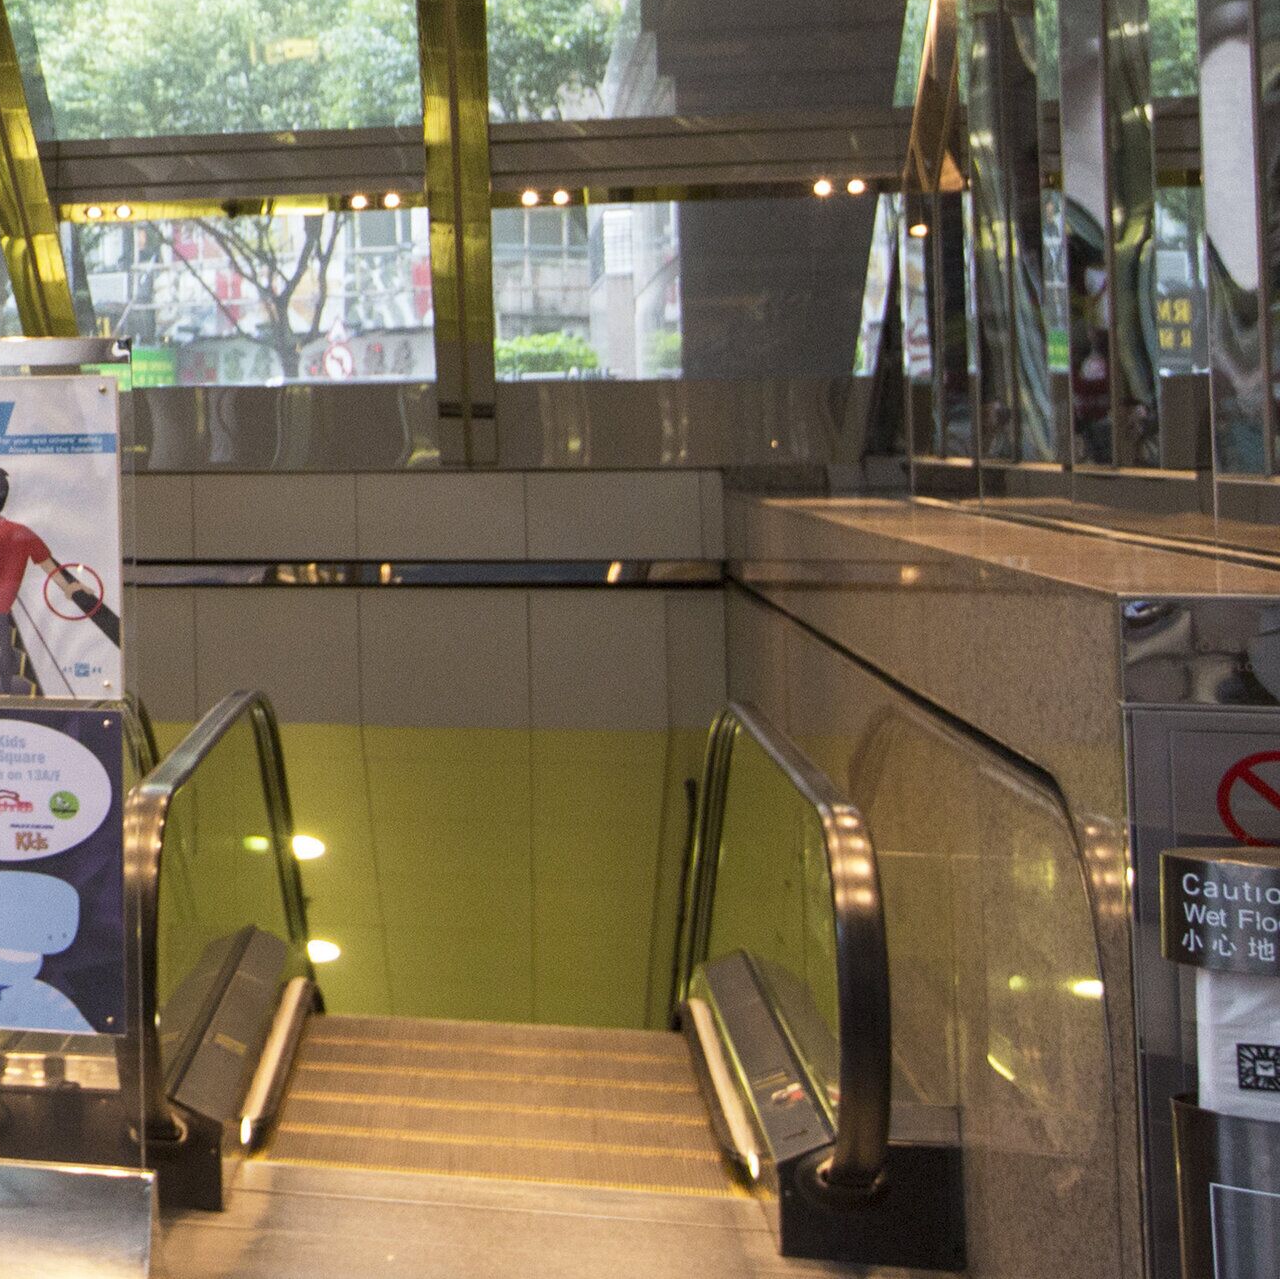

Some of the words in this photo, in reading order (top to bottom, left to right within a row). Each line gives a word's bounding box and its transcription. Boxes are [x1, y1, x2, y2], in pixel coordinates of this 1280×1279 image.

[7, 771, 22, 780] on
[1183, 902, 1227, 928] Wet
[1181, 928, 1276, 961] 小心地
